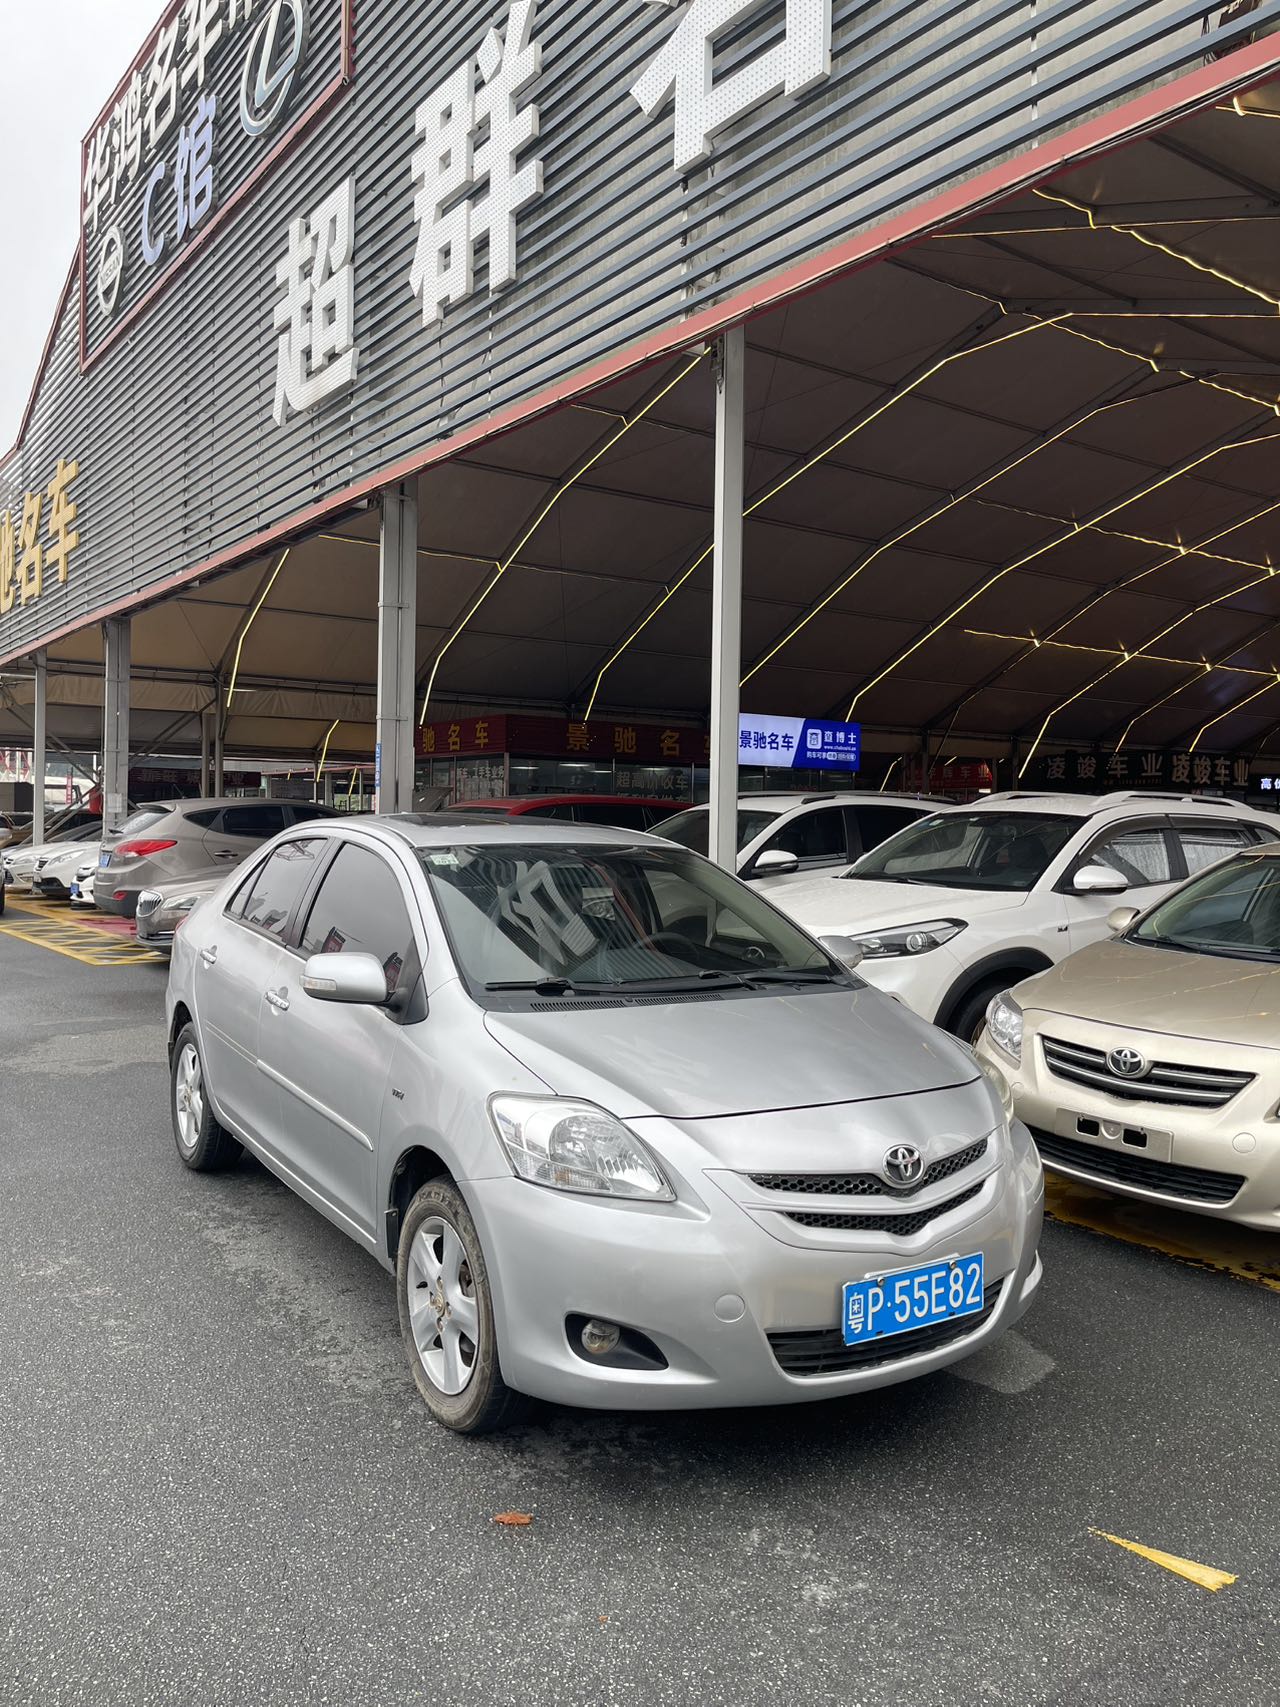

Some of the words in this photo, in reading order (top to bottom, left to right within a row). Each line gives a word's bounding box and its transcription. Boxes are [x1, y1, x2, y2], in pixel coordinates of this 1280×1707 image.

[739, 730, 794, 752] 景驰名车
[847, 1262, 981, 1335] 粤P·55E82
